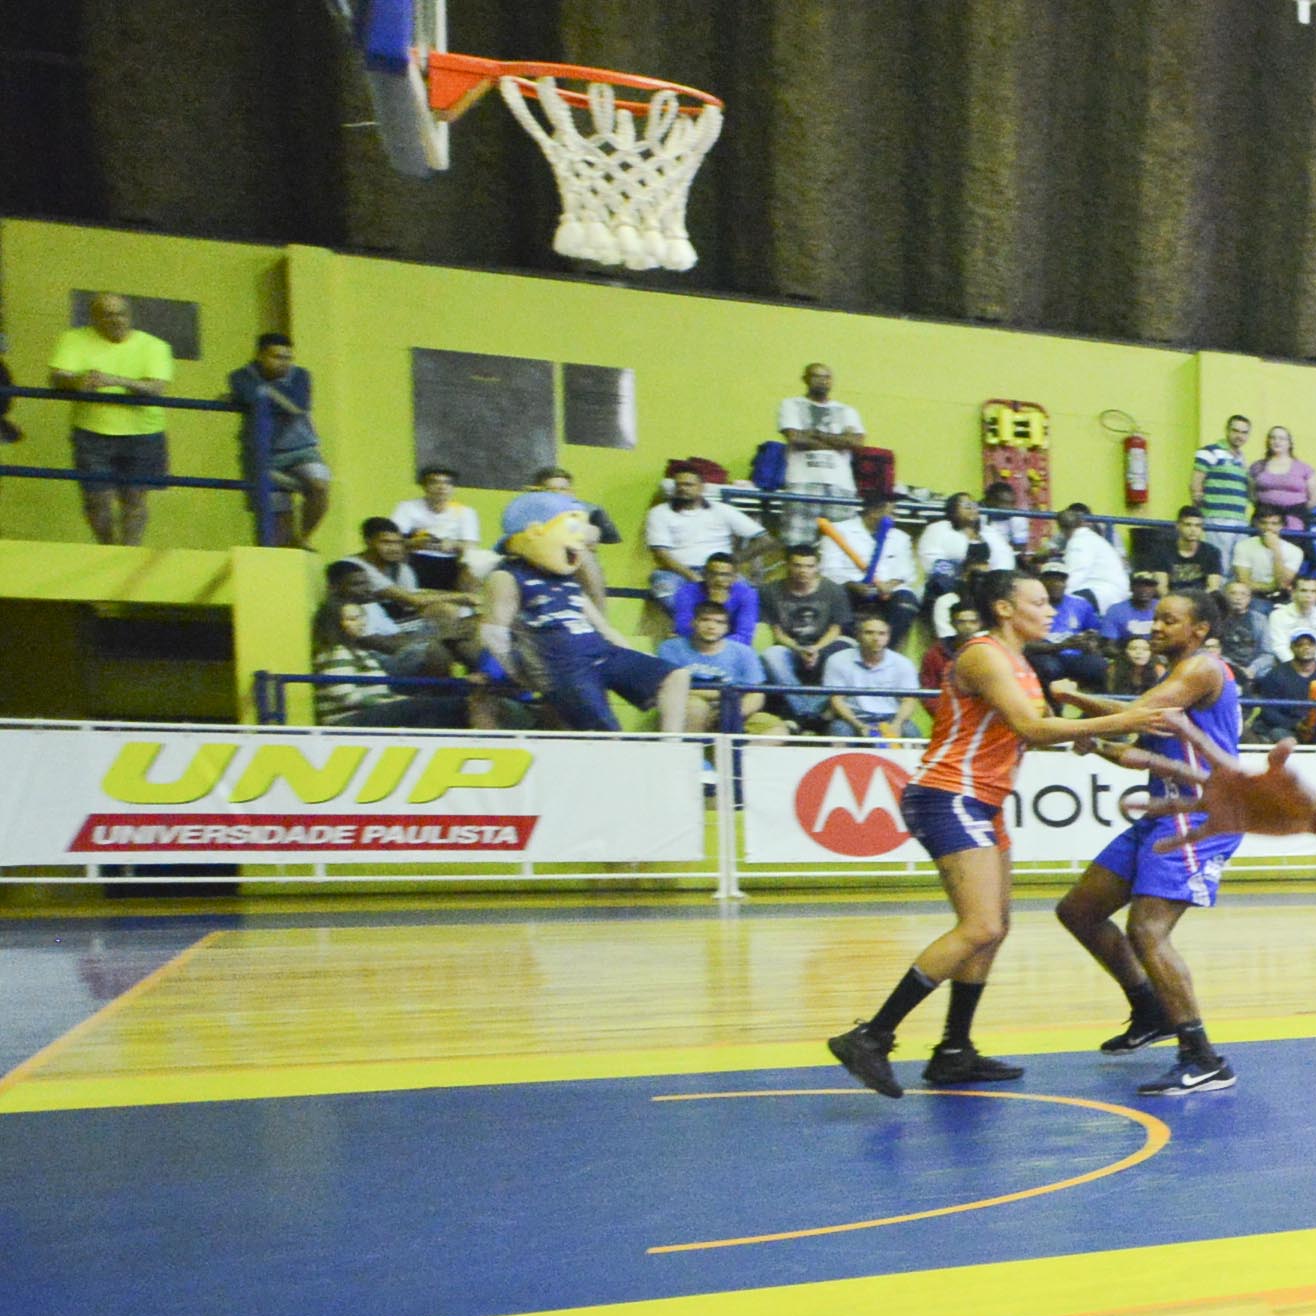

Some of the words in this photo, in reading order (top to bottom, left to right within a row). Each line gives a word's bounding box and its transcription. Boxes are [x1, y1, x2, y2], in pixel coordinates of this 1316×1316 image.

[101, 741, 535, 805] UNIP
[91, 825, 356, 846] UNIVERSIDADE
[361, 825, 520, 846] PAULISTA
